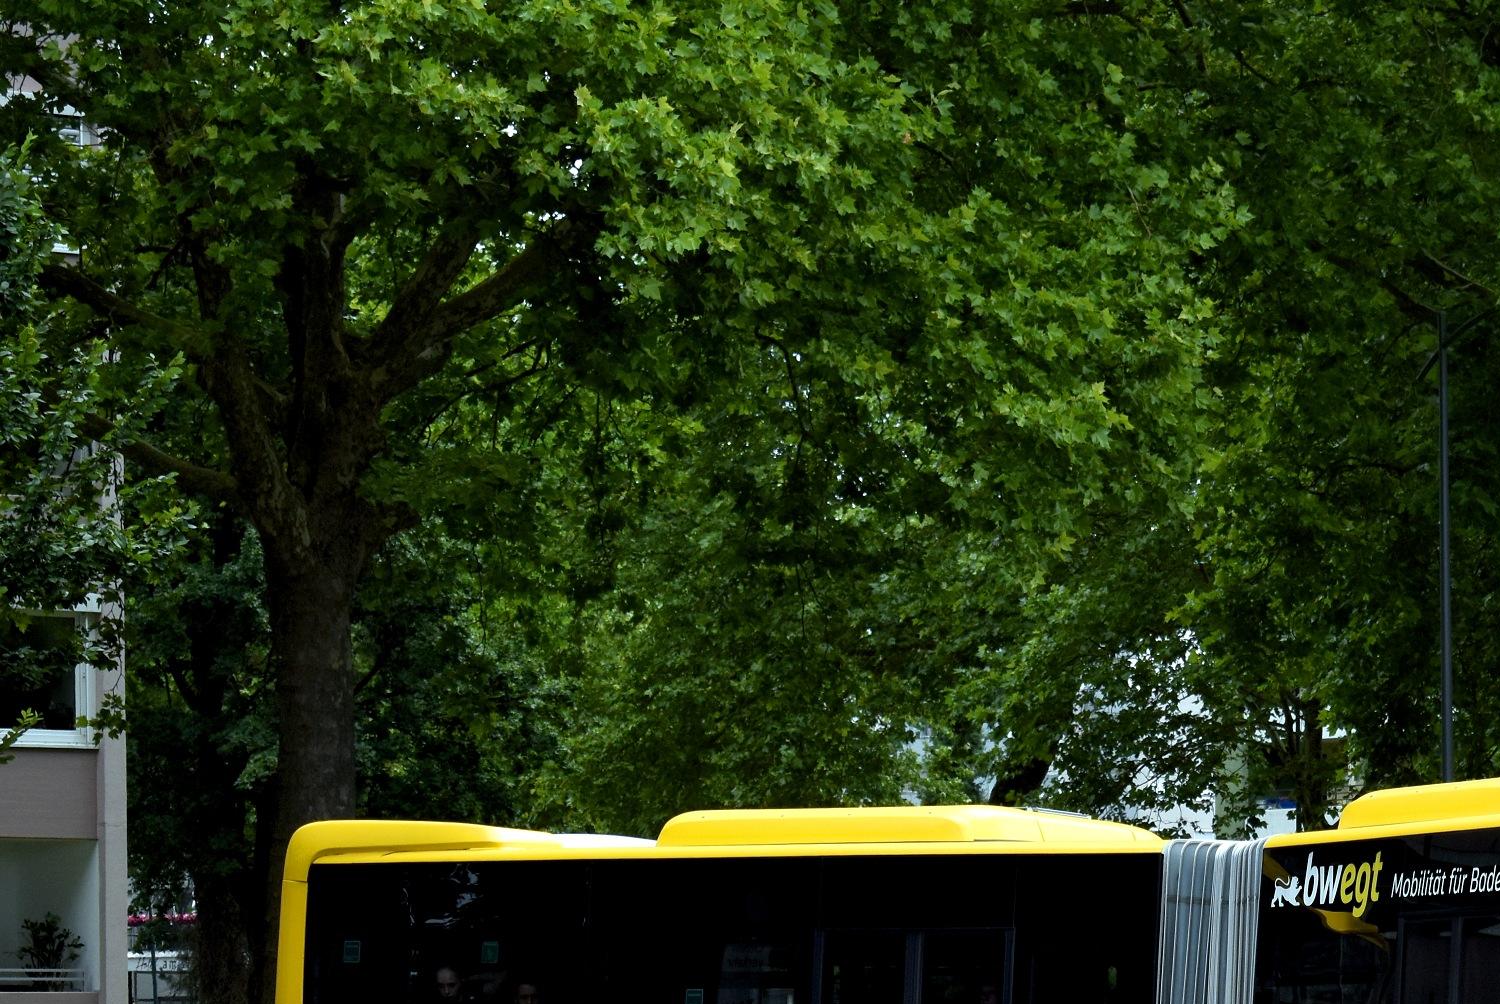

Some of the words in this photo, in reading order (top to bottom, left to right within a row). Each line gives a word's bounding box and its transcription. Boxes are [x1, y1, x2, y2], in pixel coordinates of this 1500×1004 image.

[1303, 851, 1383, 918] bwegt
[1391, 870, 1446, 899] Mobilität
[1448, 867, 1469, 896] für
